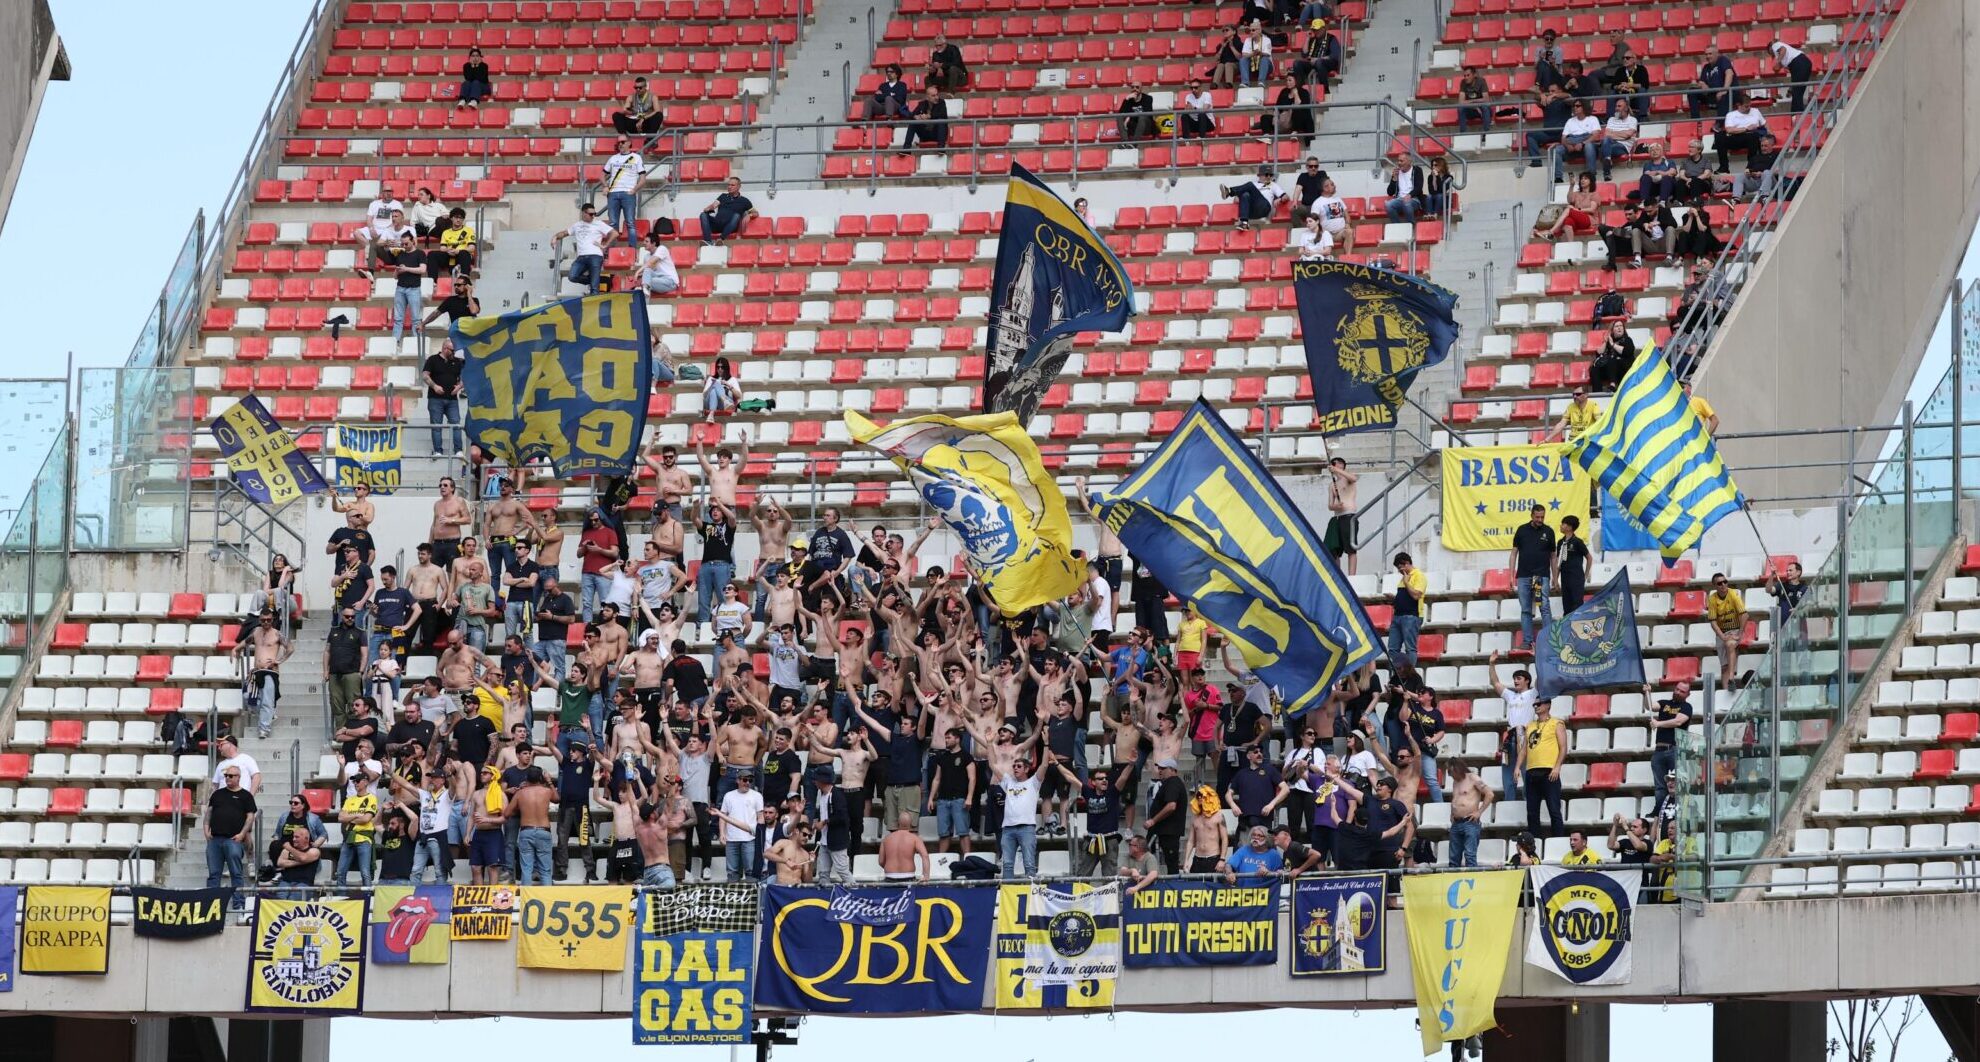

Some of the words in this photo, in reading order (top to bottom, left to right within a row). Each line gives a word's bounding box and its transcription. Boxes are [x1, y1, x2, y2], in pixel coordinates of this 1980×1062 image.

[1036, 224, 1086, 276] QBR
[1294, 264, 1371, 282] MODENA
[339, 426, 397, 453] GRUPPO
[1460, 456, 1574, 486] BASSA
[1499, 498, 1536, 512] 1989
[1483, 528, 1500, 536] SOL
[456, 887, 490, 906] PEZZI
[1322, 882, 1348, 891] Football
[1349, 881, 1365, 889] Club
[1570, 890, 1598, 901] MFC
[1134, 890, 1159, 909] NOI
[1164, 890, 1178, 908] DI
[1181, 889, 1213, 908] SAN
[1215, 888, 1270, 907] BIAGIO
[26, 905, 106, 922] GRUPPO
[138, 896, 221, 926] CABALA
[521, 898, 623, 939] 0535
[674, 905, 735, 922] Dispo
[1536, 897, 1632, 942] VGNOLA
[263, 903, 354, 951] NONANTOLA
[453, 915, 508, 936] MANCANTI
[26, 929, 104, 948] GRAPPA
[1126, 922, 1180, 954] TUTTI
[1186, 920, 1274, 953] PRESENTI
[641, 940, 746, 982] DAL
[772, 898, 972, 1003] QBR
[1562, 950, 1592, 966] 1985
[1025, 964, 1044, 974] ma
[1047, 962, 1058, 974] tu
[1062, 964, 1078, 975] mi
[1078, 962, 1117, 978] capirai
[262, 964, 352, 1003] GIALLOBLU
[640, 989, 744, 1031] GAS
